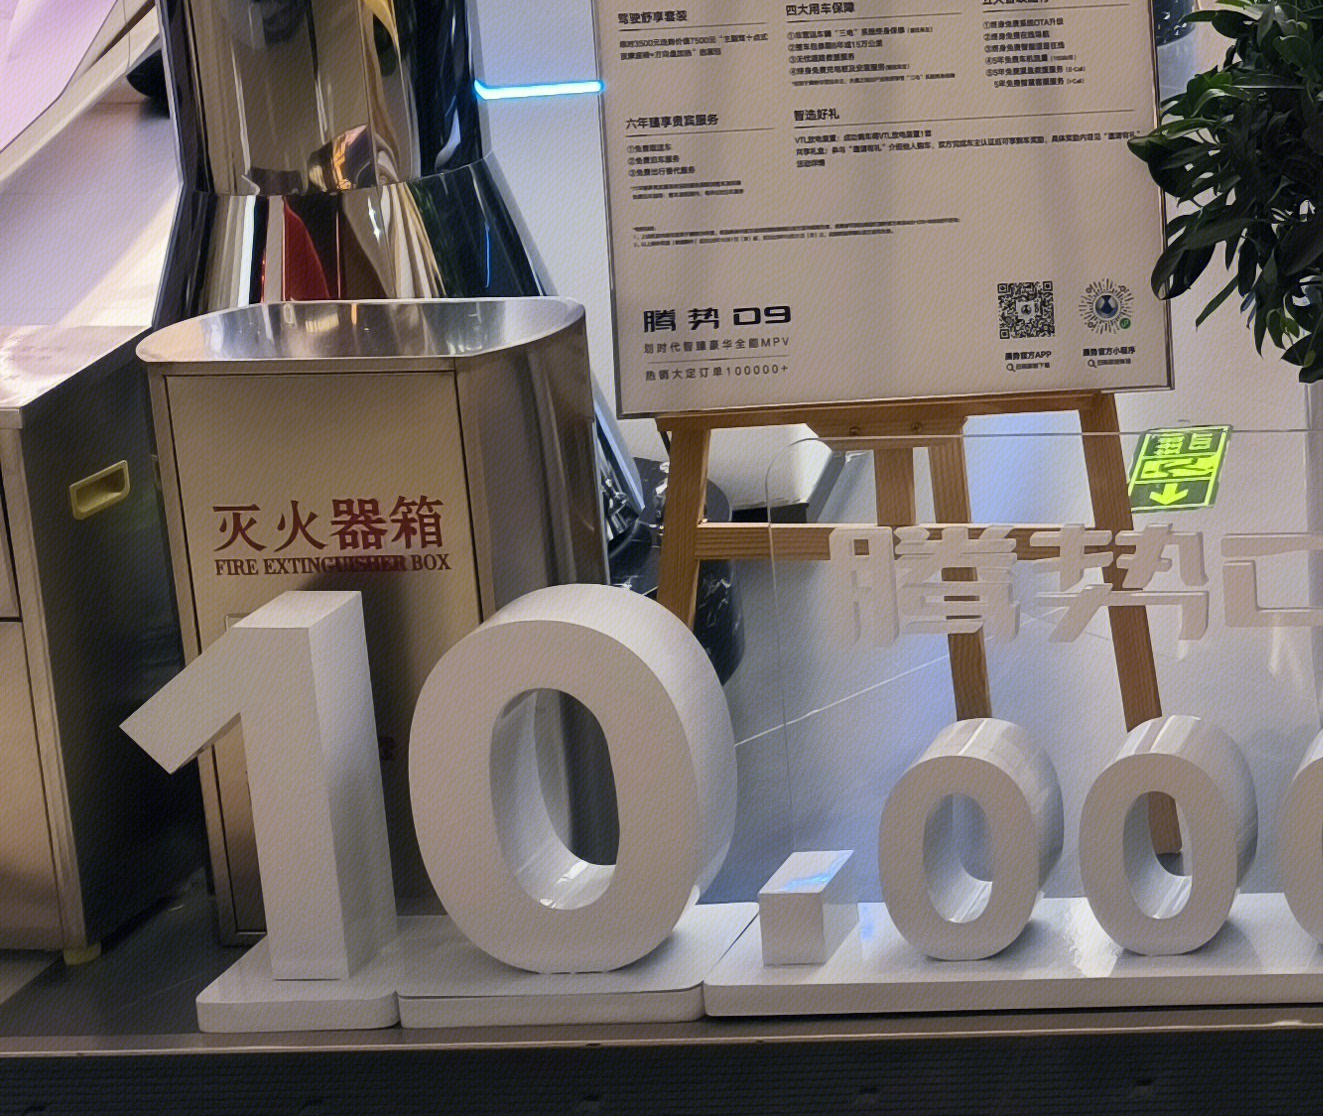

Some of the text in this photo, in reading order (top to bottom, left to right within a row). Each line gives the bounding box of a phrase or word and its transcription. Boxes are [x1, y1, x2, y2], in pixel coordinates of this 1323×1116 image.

[785, 2, 855, 16] 四大用车保障
[212, 495, 444, 553] 灭火器箱
[214, 553, 452, 576] FIRE EXTINGUISHER BOX
